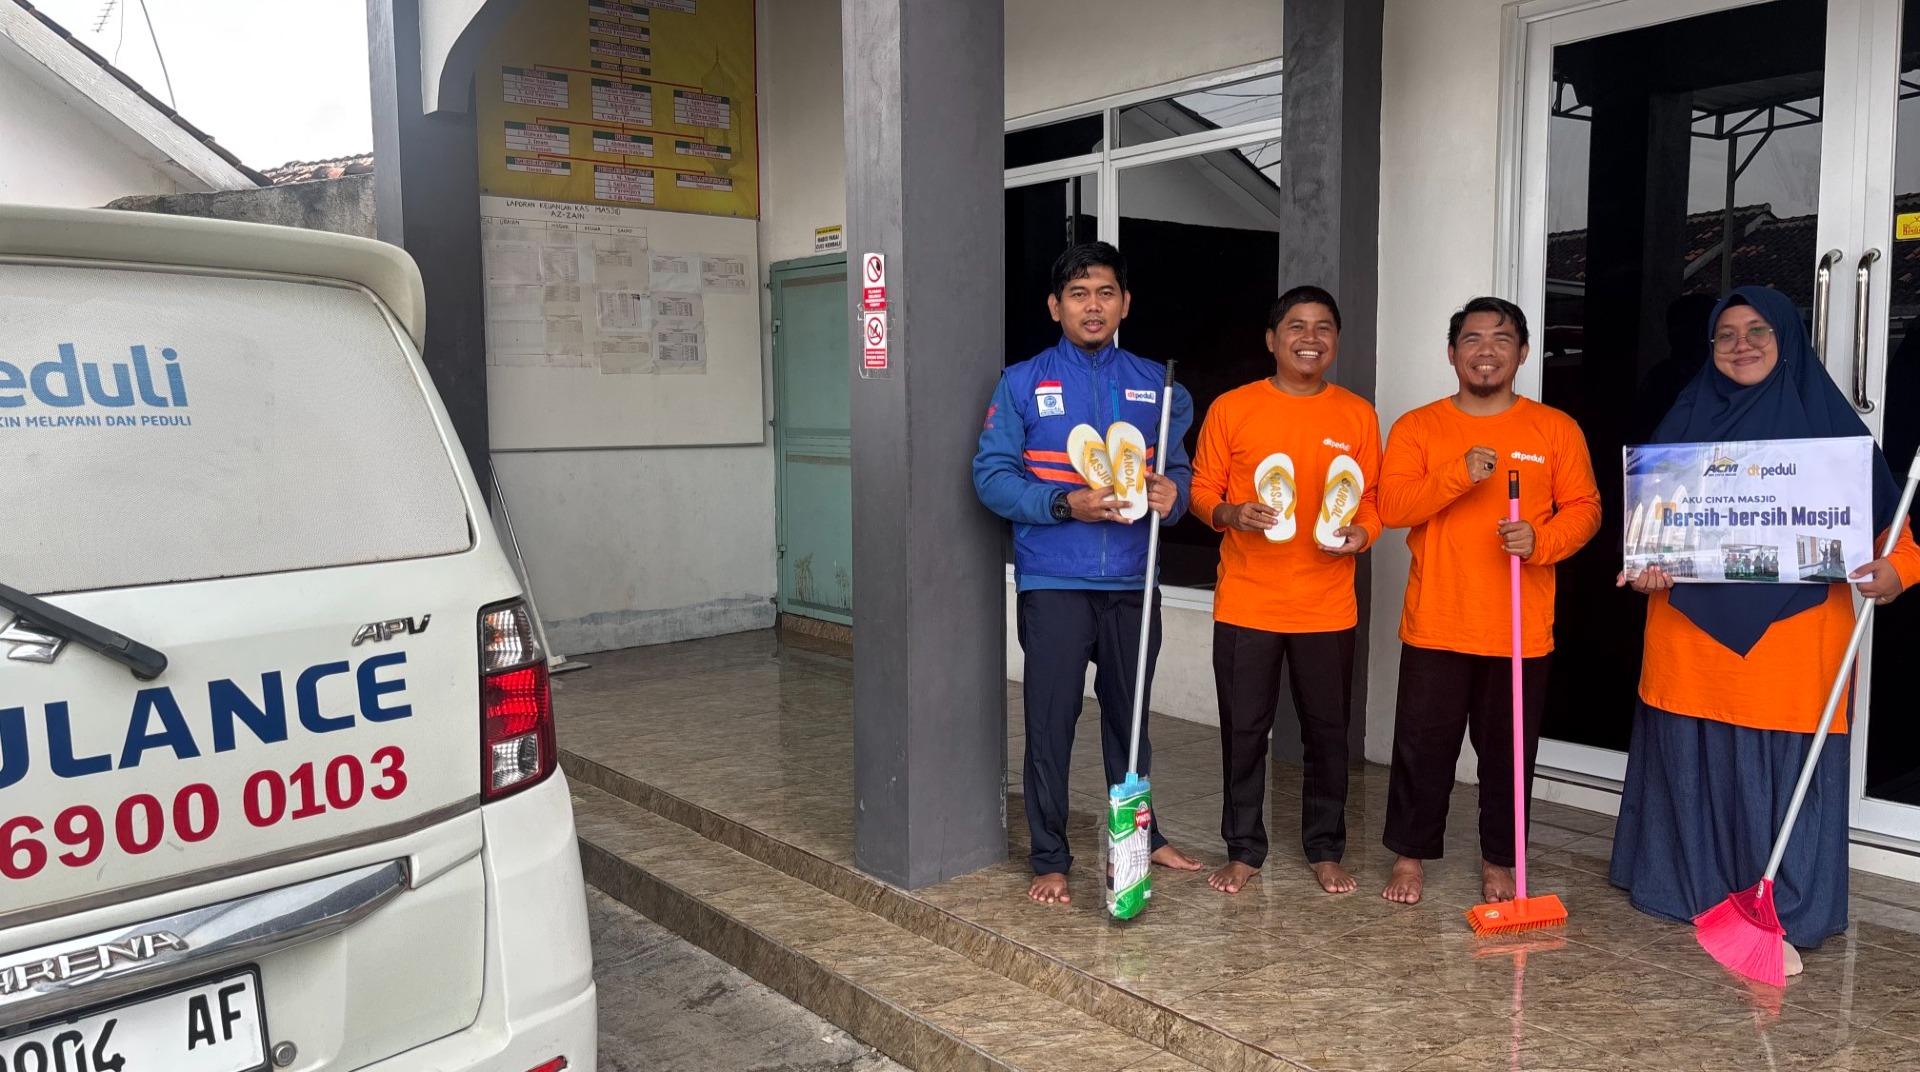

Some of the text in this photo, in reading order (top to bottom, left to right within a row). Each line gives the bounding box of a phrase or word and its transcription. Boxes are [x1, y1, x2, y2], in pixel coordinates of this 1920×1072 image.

[550, 210, 585, 220] AZ-ZAIN
[594, 206, 620, 216] MASJID
[26, 416, 101, 427] MELAYANI
[106, 416, 136, 426] DAN
[142, 416, 192, 426] PEDULI
[1703, 464, 1738, 476] ACM
[1331, 478, 1351, 518] SANDAL
[1663, 506, 1850, 530] Bersih-bersih Masjid
[352, 614, 432, 646] APV
[0, 745, 408, 880] 6900 0103
[188, 982, 246, 1051] AF
